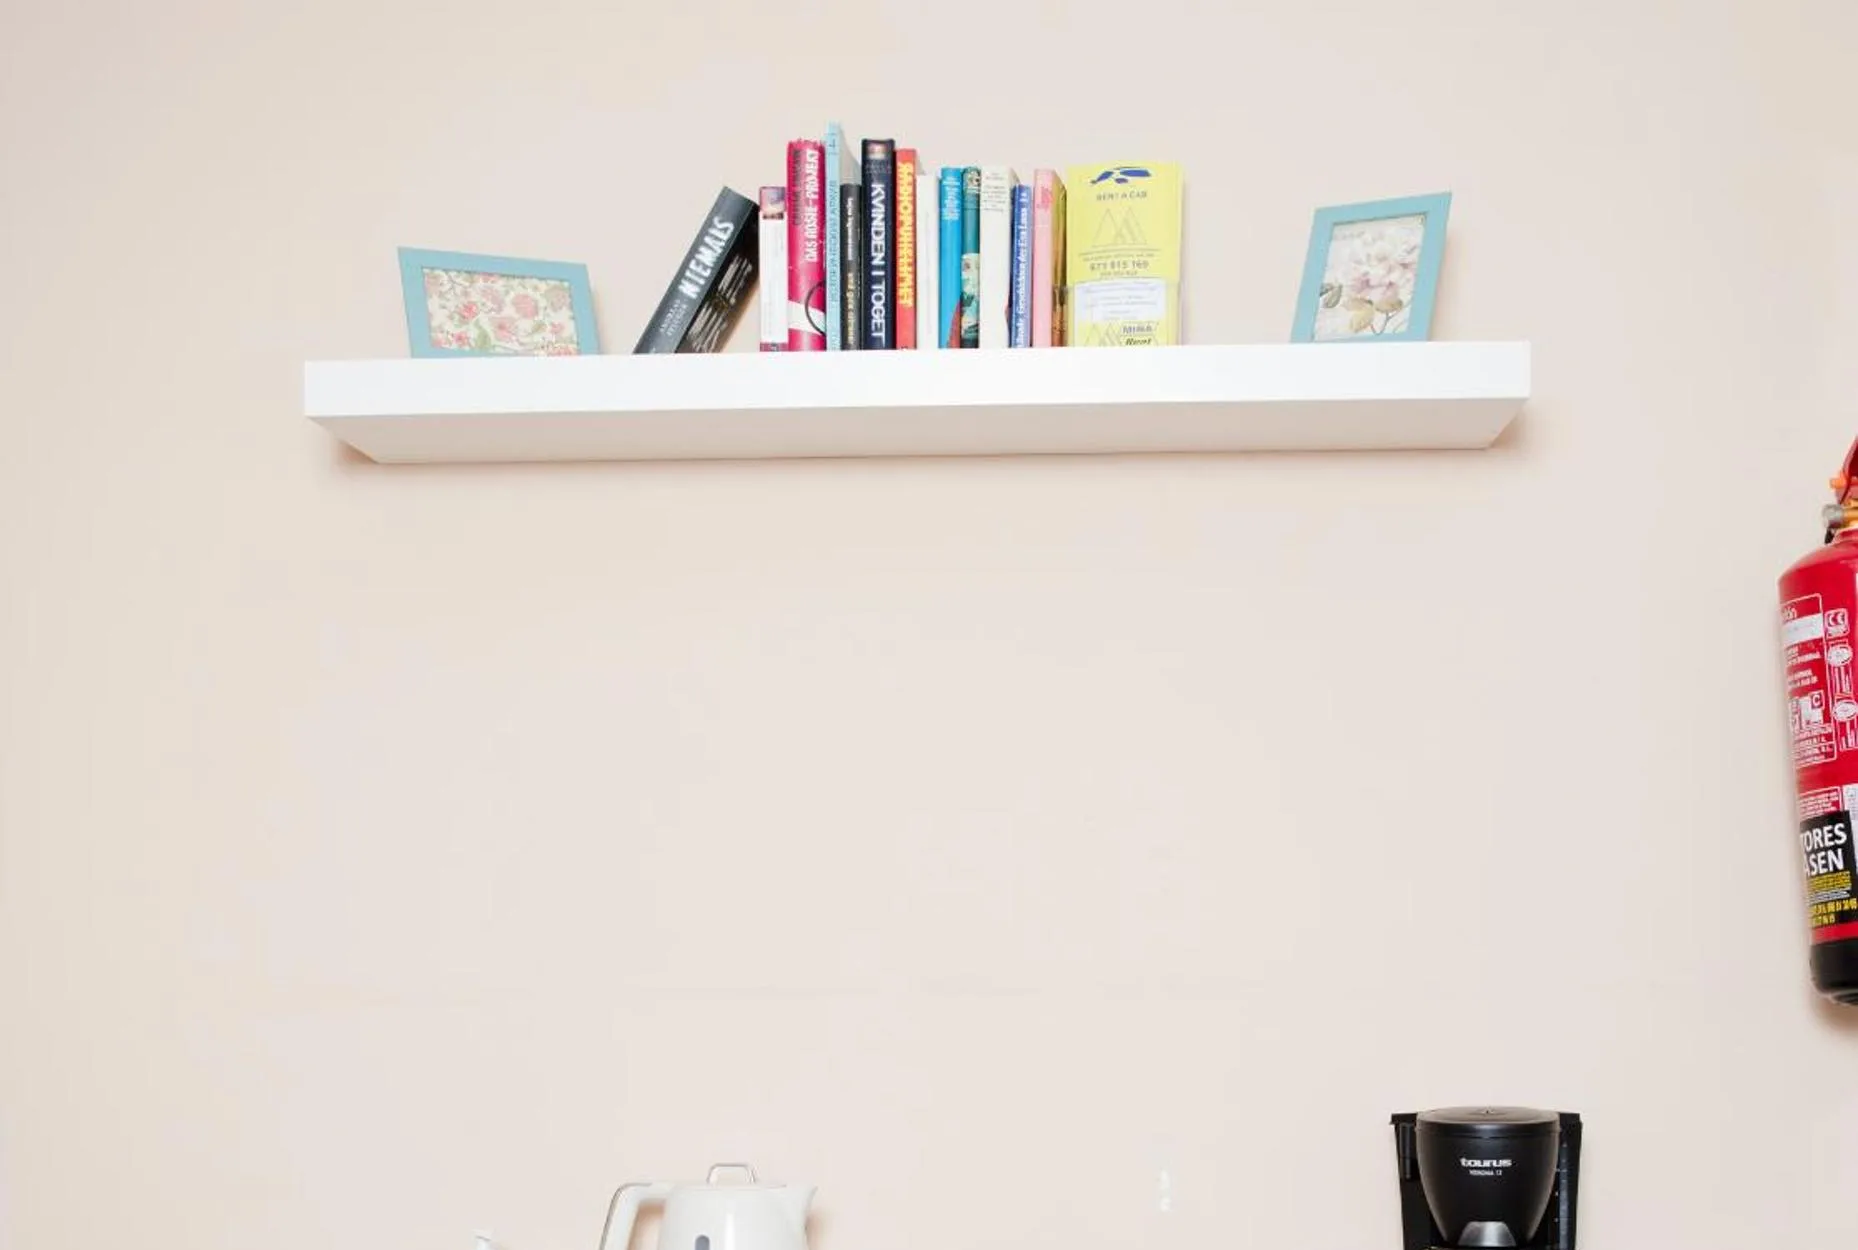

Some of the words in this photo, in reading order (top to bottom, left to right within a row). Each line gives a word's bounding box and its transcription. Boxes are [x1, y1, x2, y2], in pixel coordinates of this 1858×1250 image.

[678, 216, 734, 299] NIEMALS
[871, 184, 886, 265] KVINDEN
[871, 279, 886, 344] TOGET
[1459, 1156, 1513, 1169] taurus
